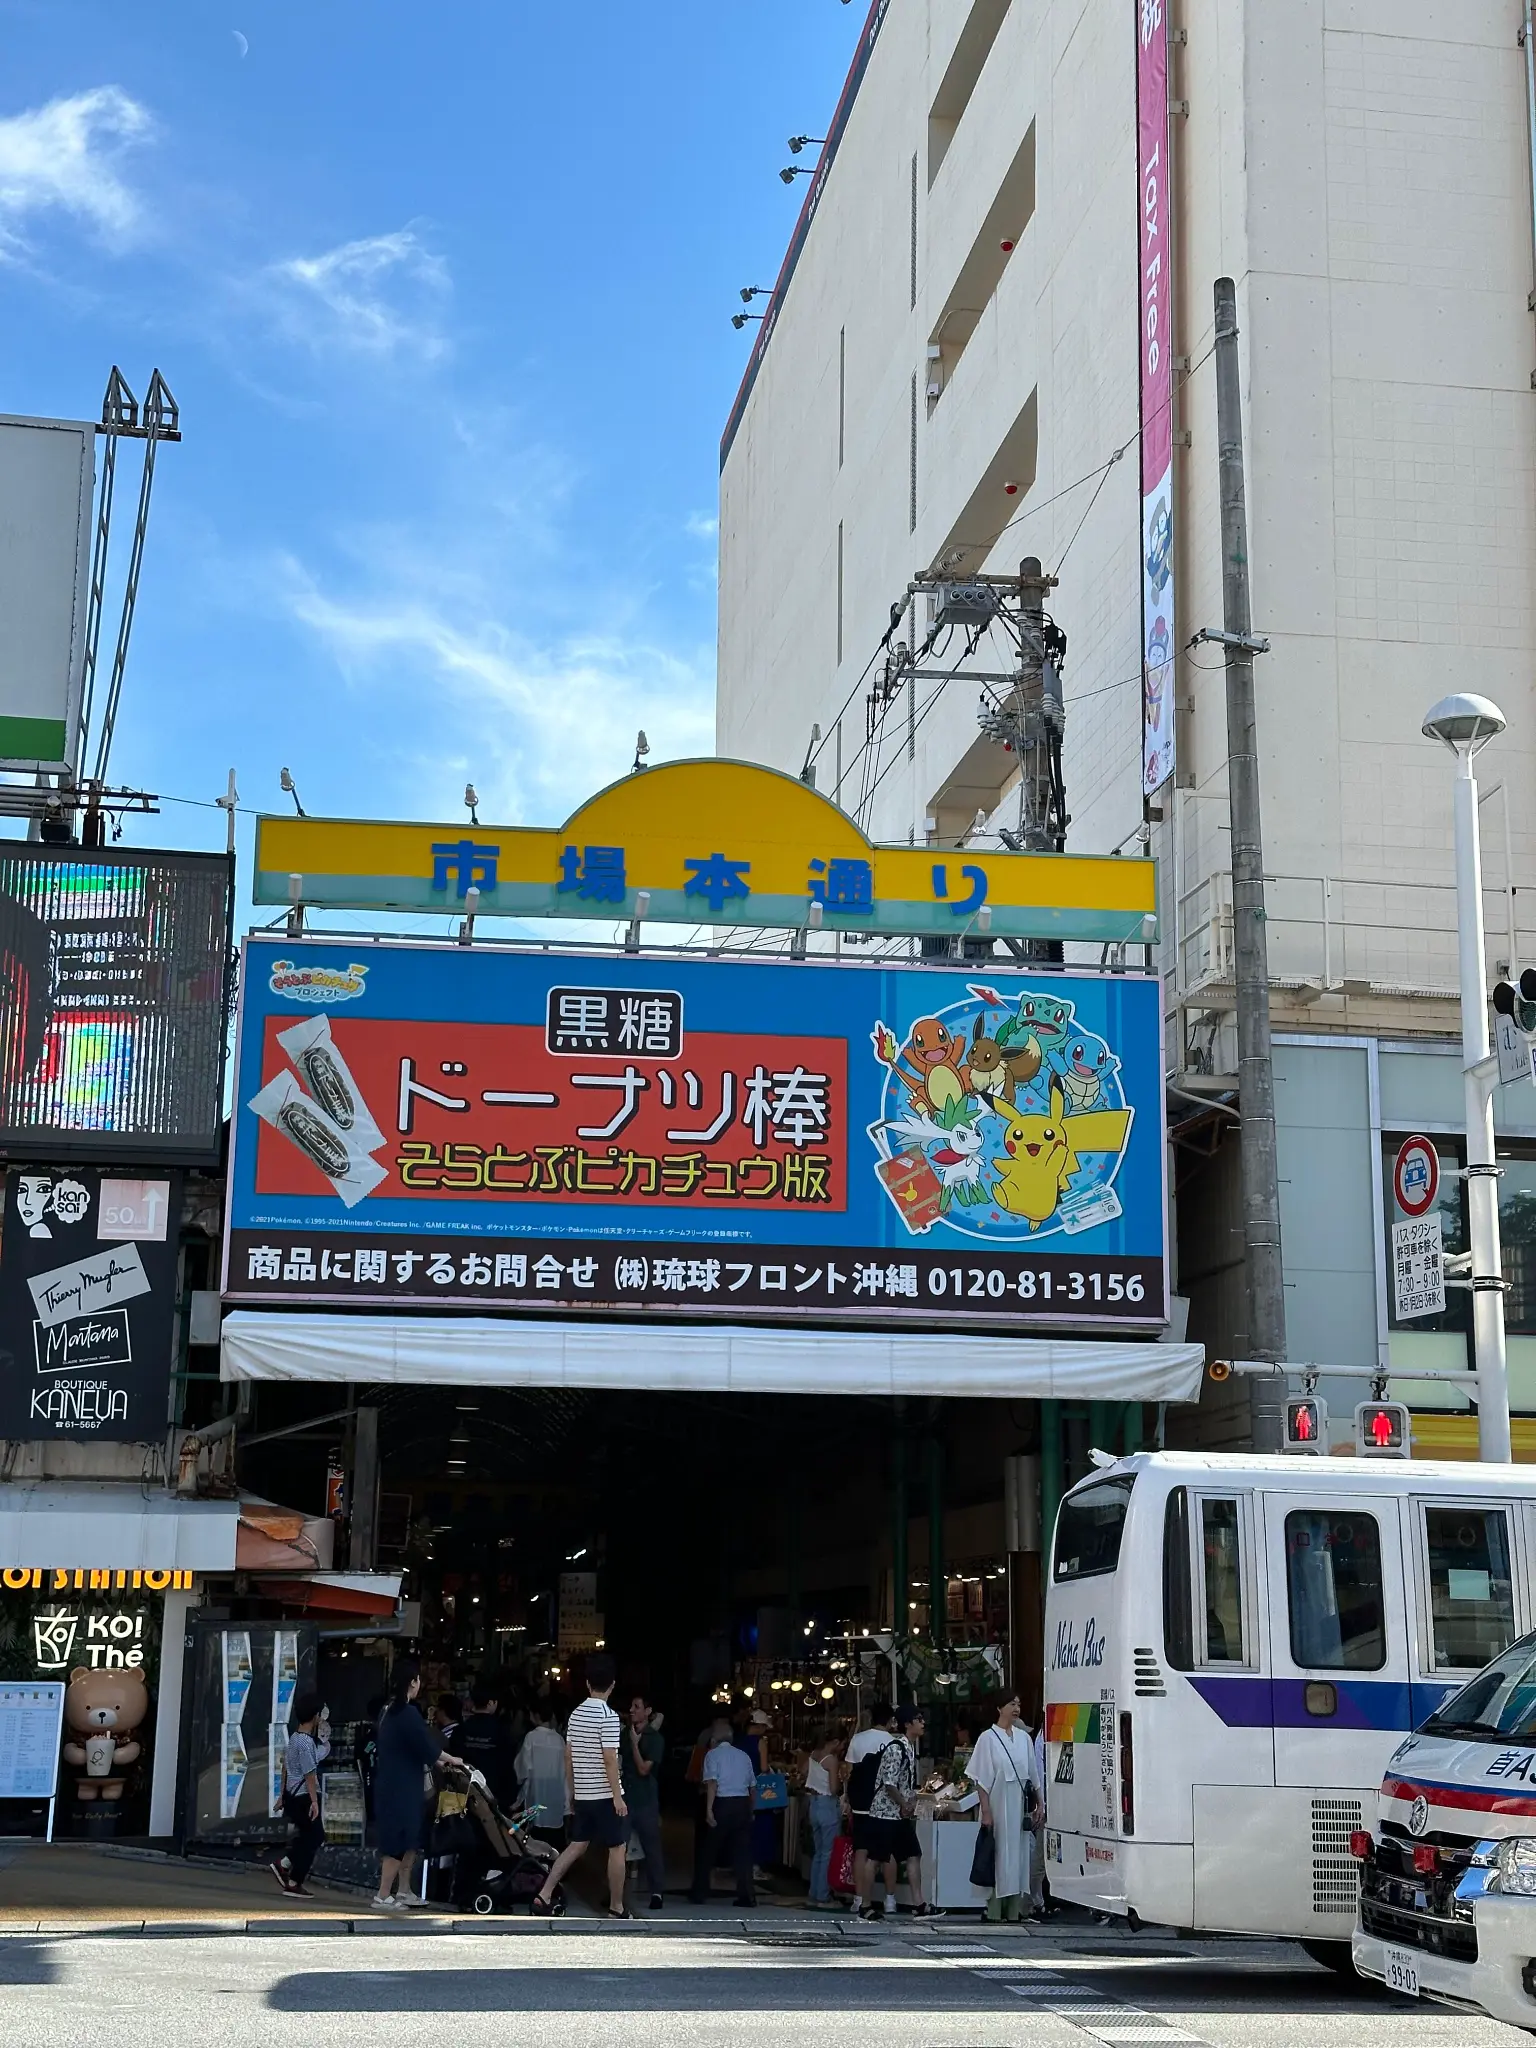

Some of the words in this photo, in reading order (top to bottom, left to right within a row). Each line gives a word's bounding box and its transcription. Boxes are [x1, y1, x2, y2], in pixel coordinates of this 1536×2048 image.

[1147, 252, 1160, 375] Free
[431, 840, 988, 916] 市場本通り
[295, 987, 340, 997] プロジェクト
[555, 993, 677, 1052] 黒糖
[397, 1057, 830, 1148] ドーナツ棒
[397, 1142, 829, 1203] そらとぶピカチュウ版
[56, 1201, 80, 1214] sai
[57, 1186, 88, 1203] kan
[447, 1222, 470, 1230] FREAK
[39, 1281, 82, 1313] Thierry
[79, 1260, 138, 1293] Mugler
[247, 1245, 598, 1290] 商品に関するお問合せ
[613, 1255, 918, 1298] (株)琉球フロント沖縄
[927, 1267, 1145, 1302] 0120-81-3156
[1398, 1276, 1414, 1294] 7:30
[1423, 1270, 1440, 1288] 9:00
[46, 1321, 119, 1364] Montana
[54, 1380, 108, 1390] BOUTIQUE
[65, 1420, 101, 1429] 61-5667
[88, 1615, 143, 1638] KOI
[86, 1644, 144, 1668] Thé
[1052, 1620, 1080, 1671] Naha
[1081, 1616, 1106, 1667] Bus
